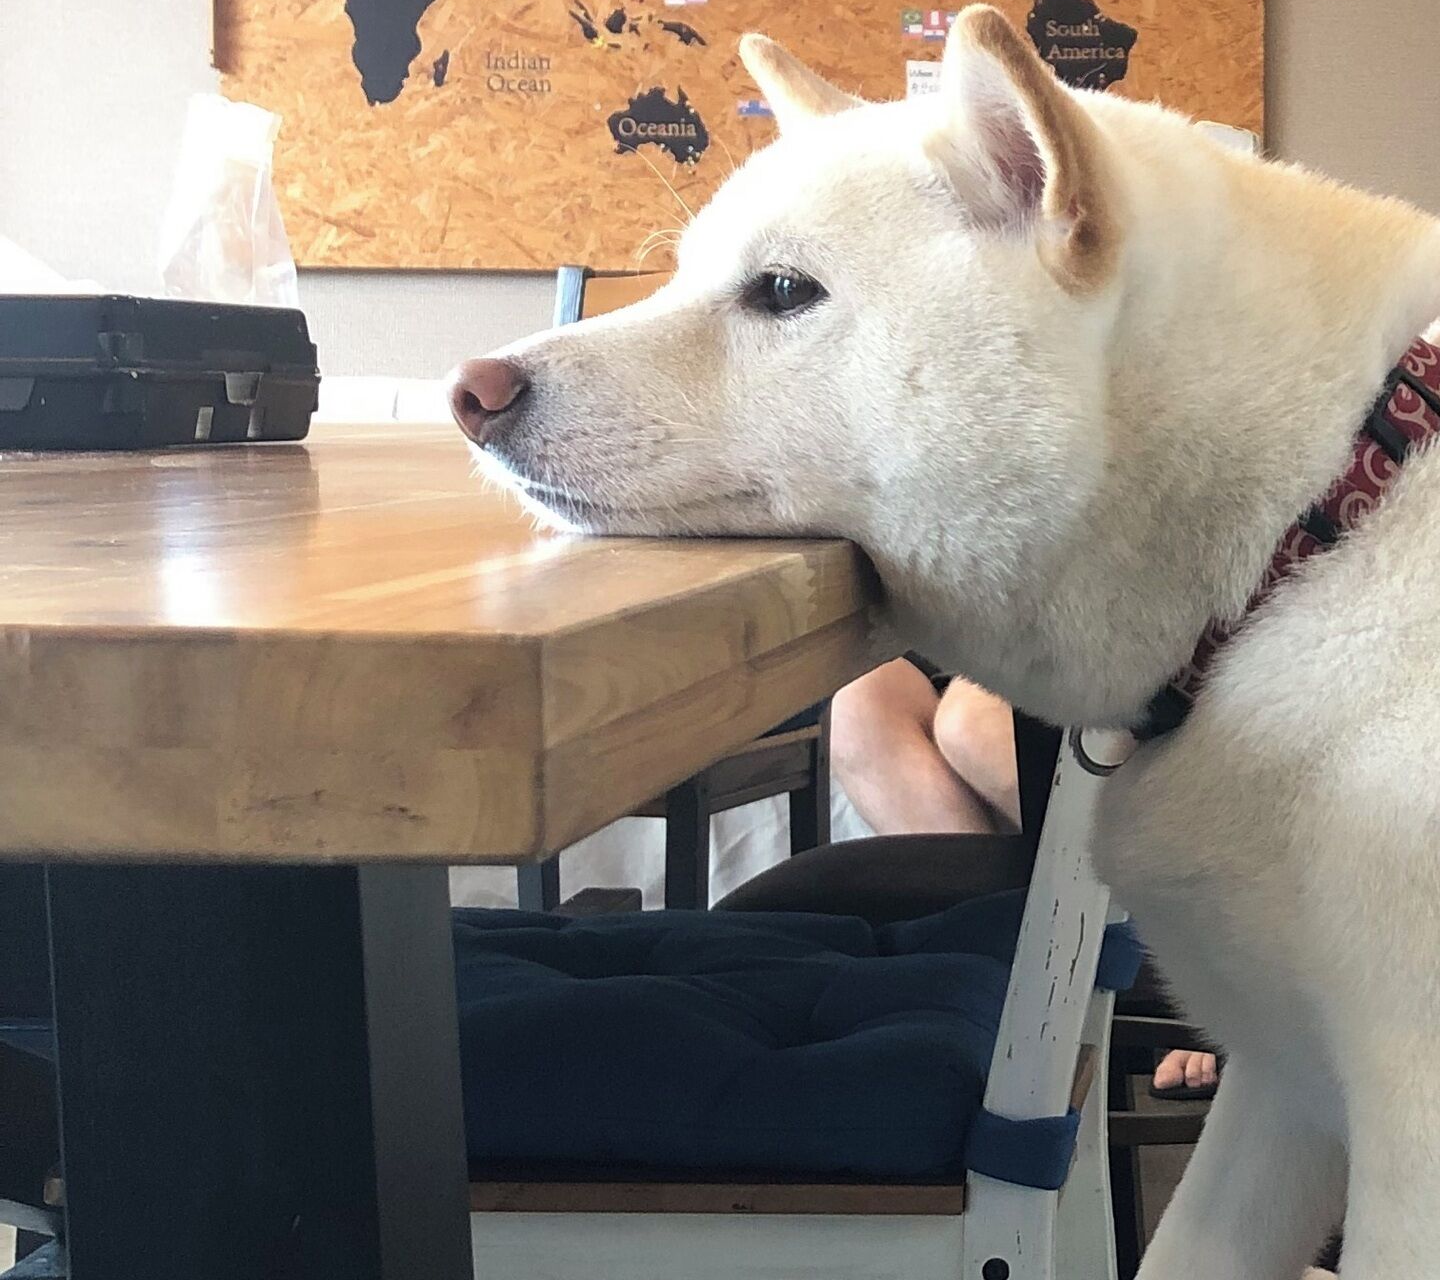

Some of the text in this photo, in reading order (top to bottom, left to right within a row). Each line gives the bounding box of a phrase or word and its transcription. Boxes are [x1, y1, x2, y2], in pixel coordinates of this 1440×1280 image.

[1046, 19, 1100, 39] South
[486, 51, 551, 72] Indian
[1047, 43, 1126, 61] America
[487, 74, 552, 94] Ocean
[618, 117, 697, 139] Oceania
